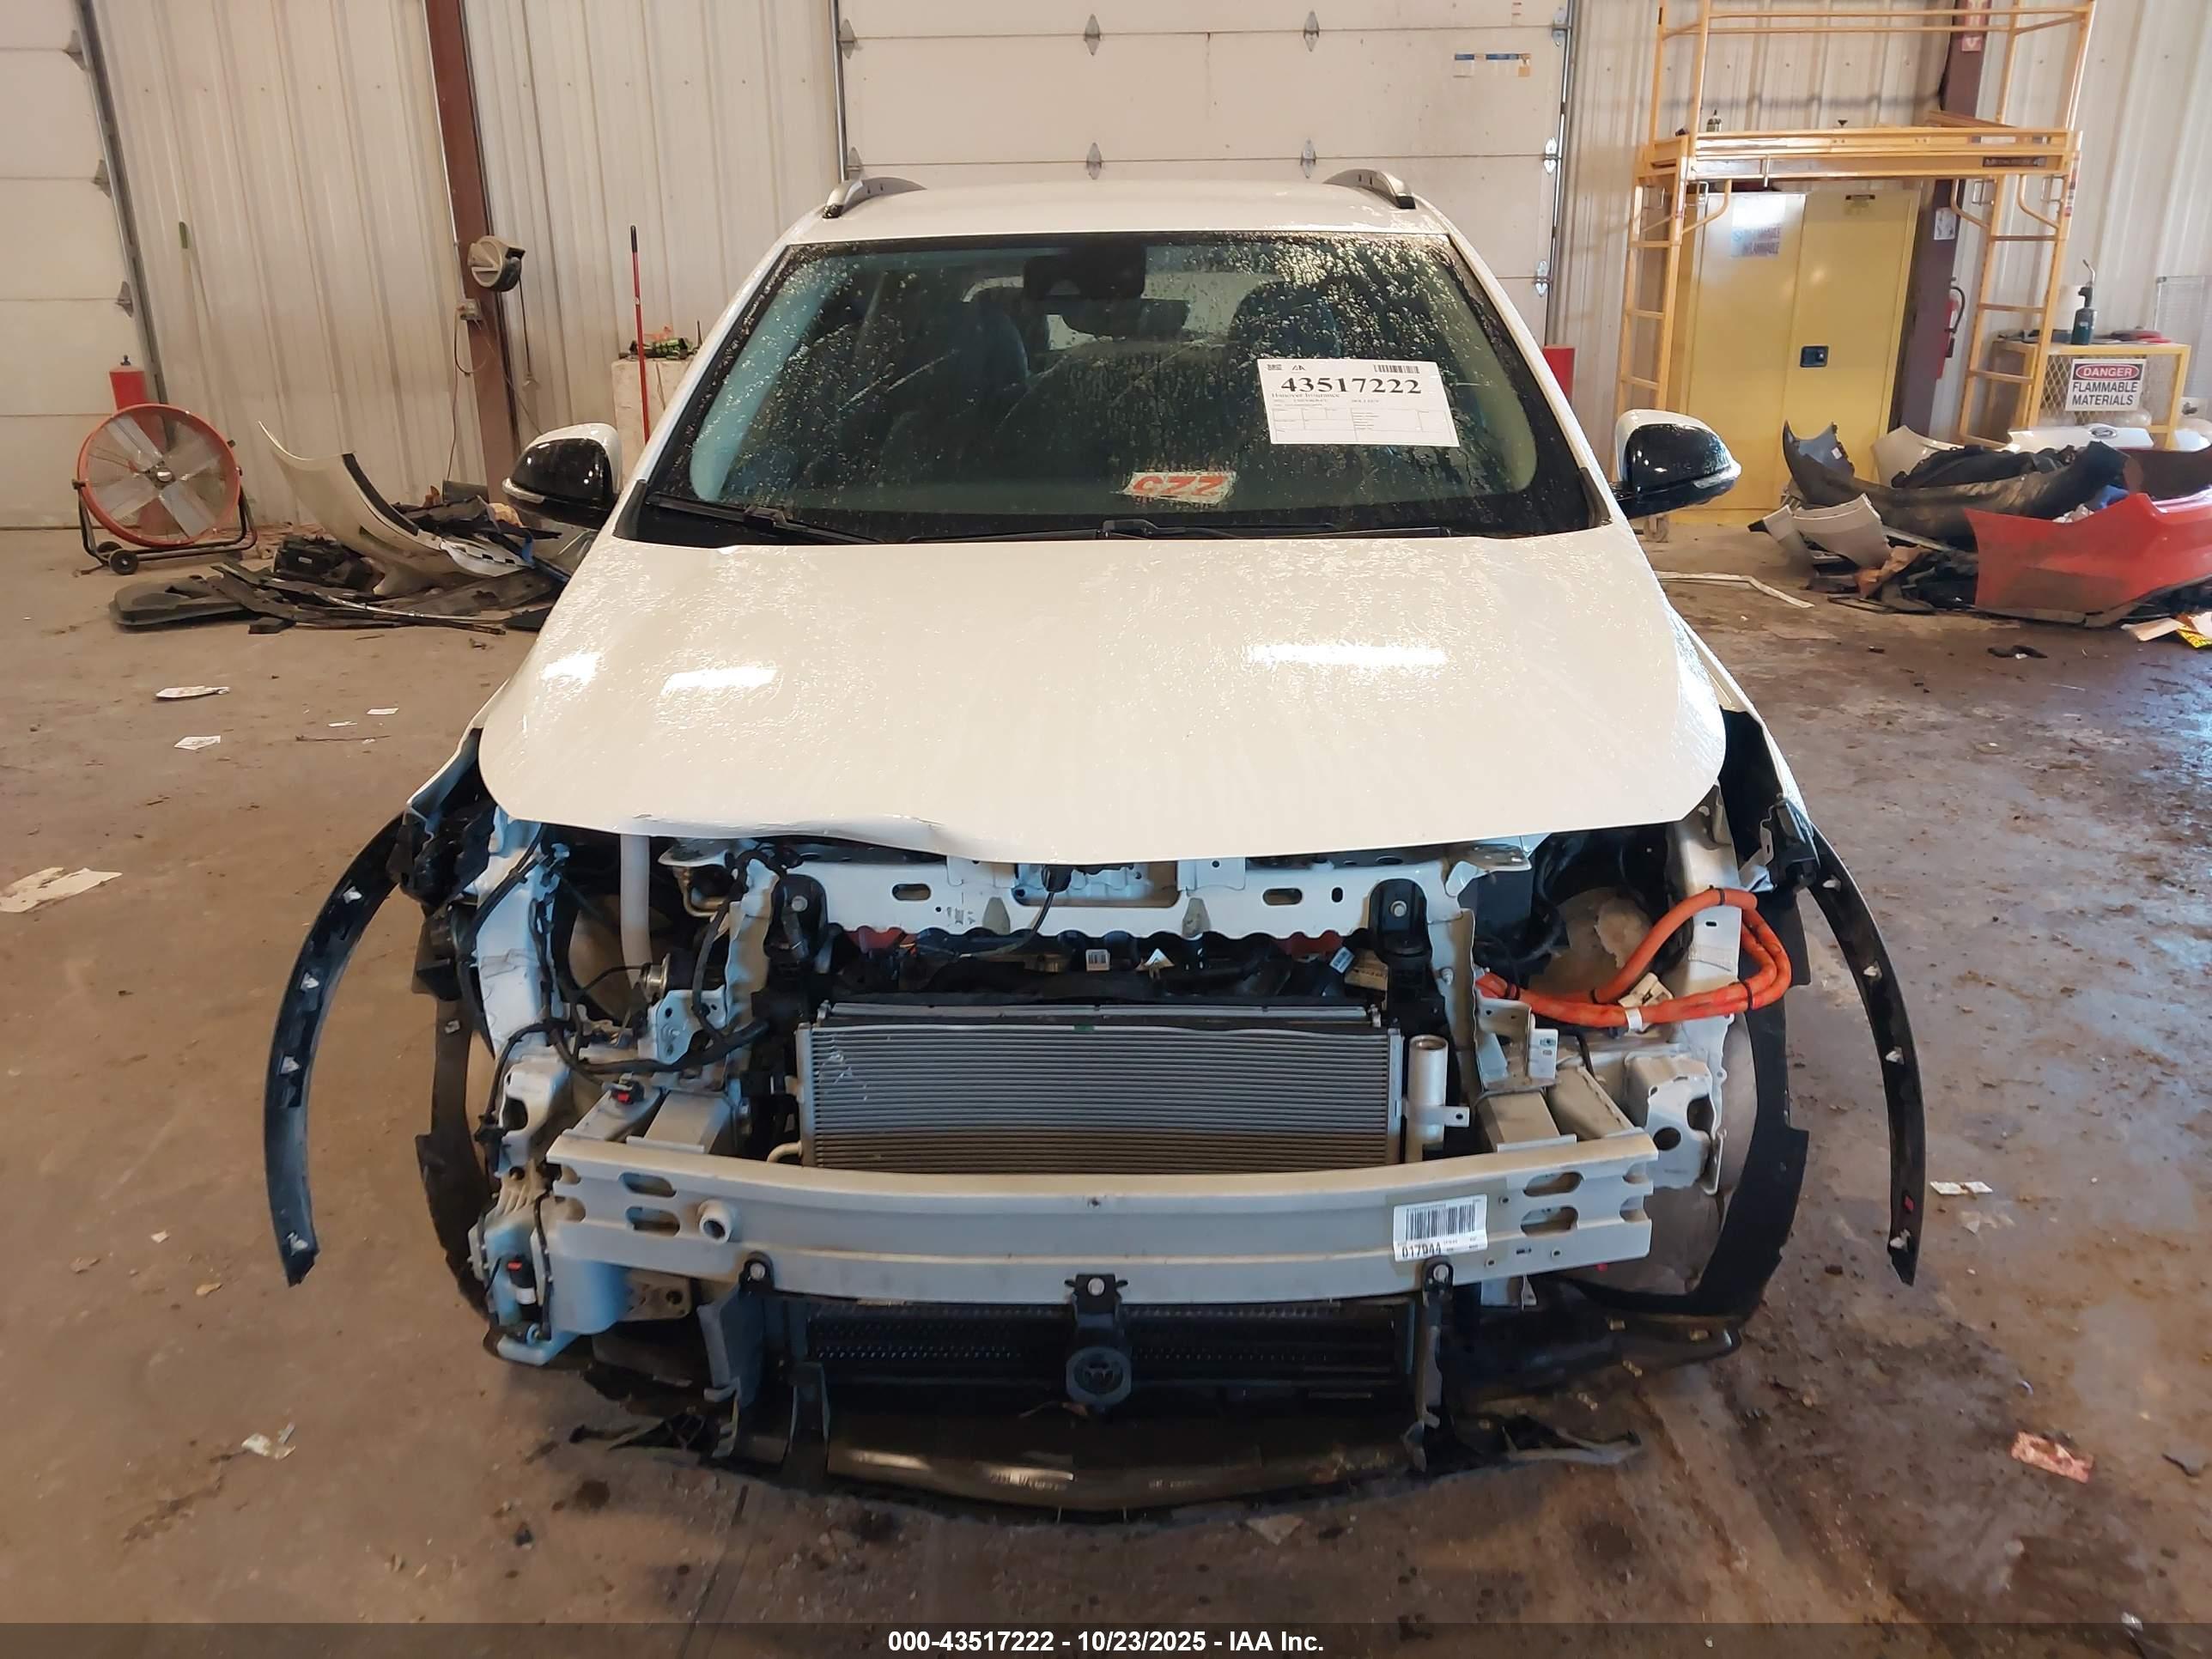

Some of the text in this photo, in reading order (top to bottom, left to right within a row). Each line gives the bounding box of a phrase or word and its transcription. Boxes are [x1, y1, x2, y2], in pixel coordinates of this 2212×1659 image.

[2083, 368, 2132, 376] DANGER
[1280, 378, 1421, 394] 43517222
[2072, 382, 2138, 392] FLAMMABLE
[2072, 395, 2133, 405] MATERIALS
